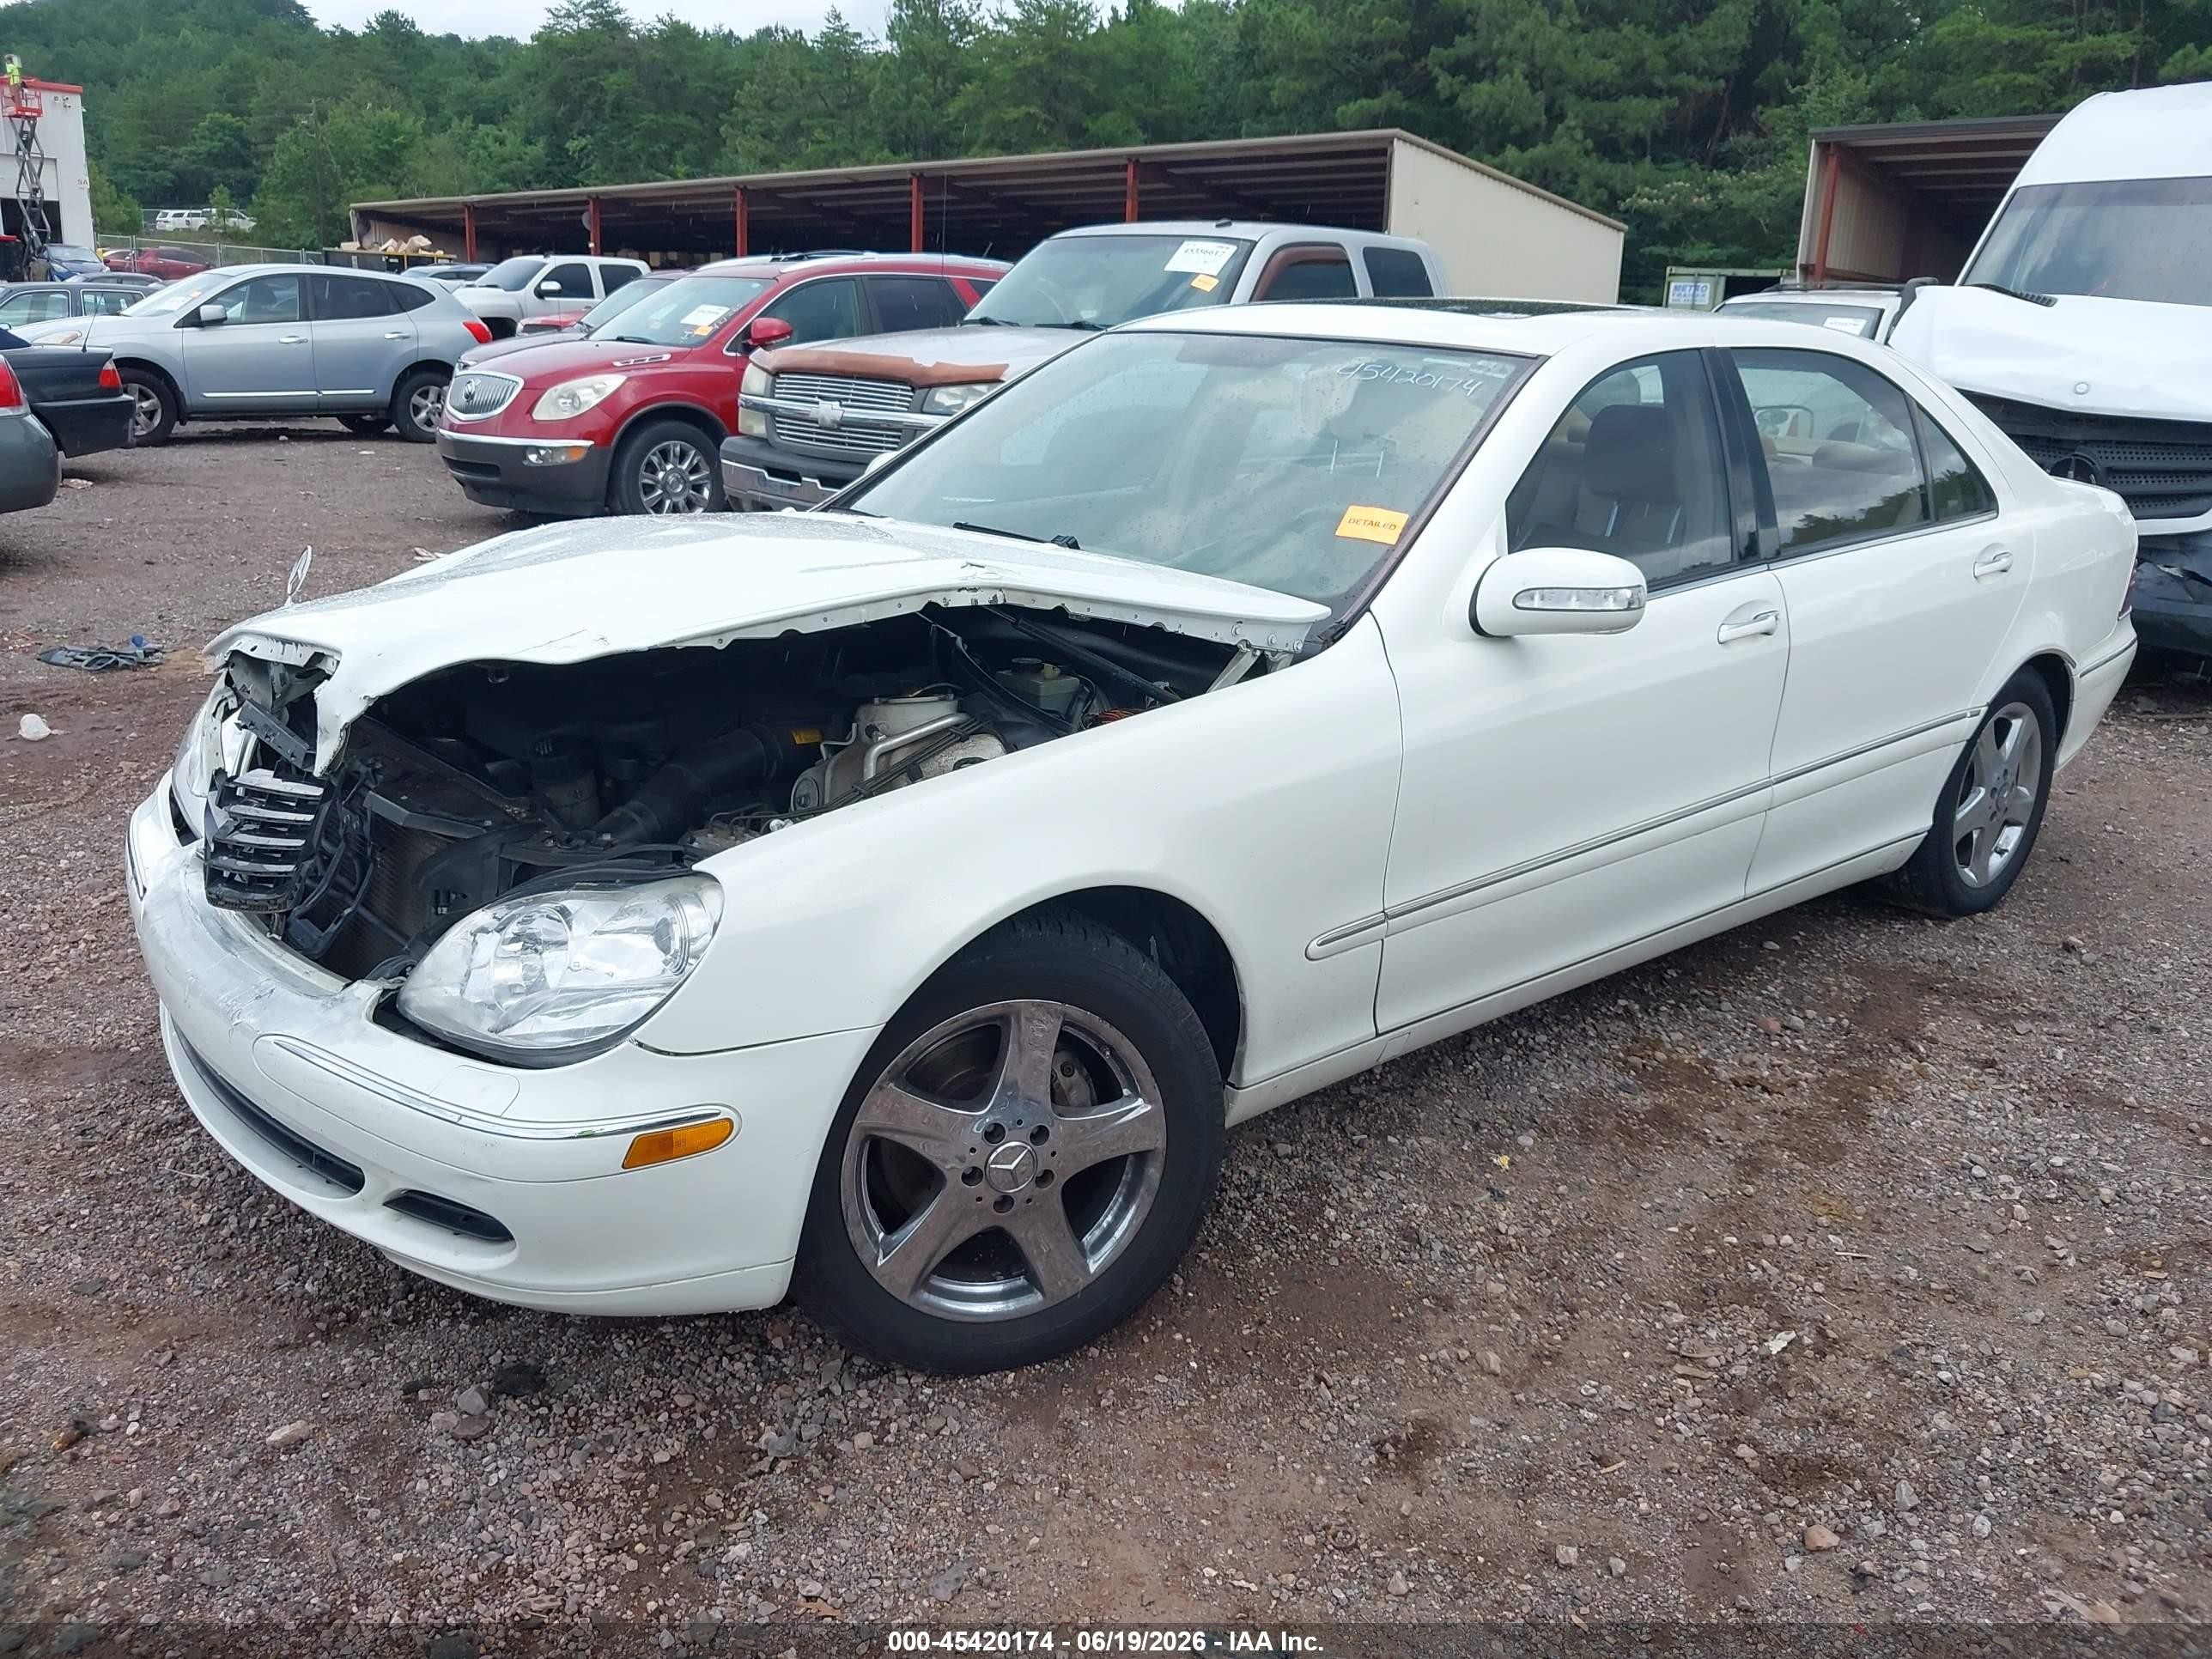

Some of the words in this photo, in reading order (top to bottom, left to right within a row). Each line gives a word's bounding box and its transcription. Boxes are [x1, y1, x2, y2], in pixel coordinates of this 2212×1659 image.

[1673, 284, 1709, 293] METRO
[1336, 362, 1482, 396] 45420174
[1347, 518, 1397, 530] DETAILED
